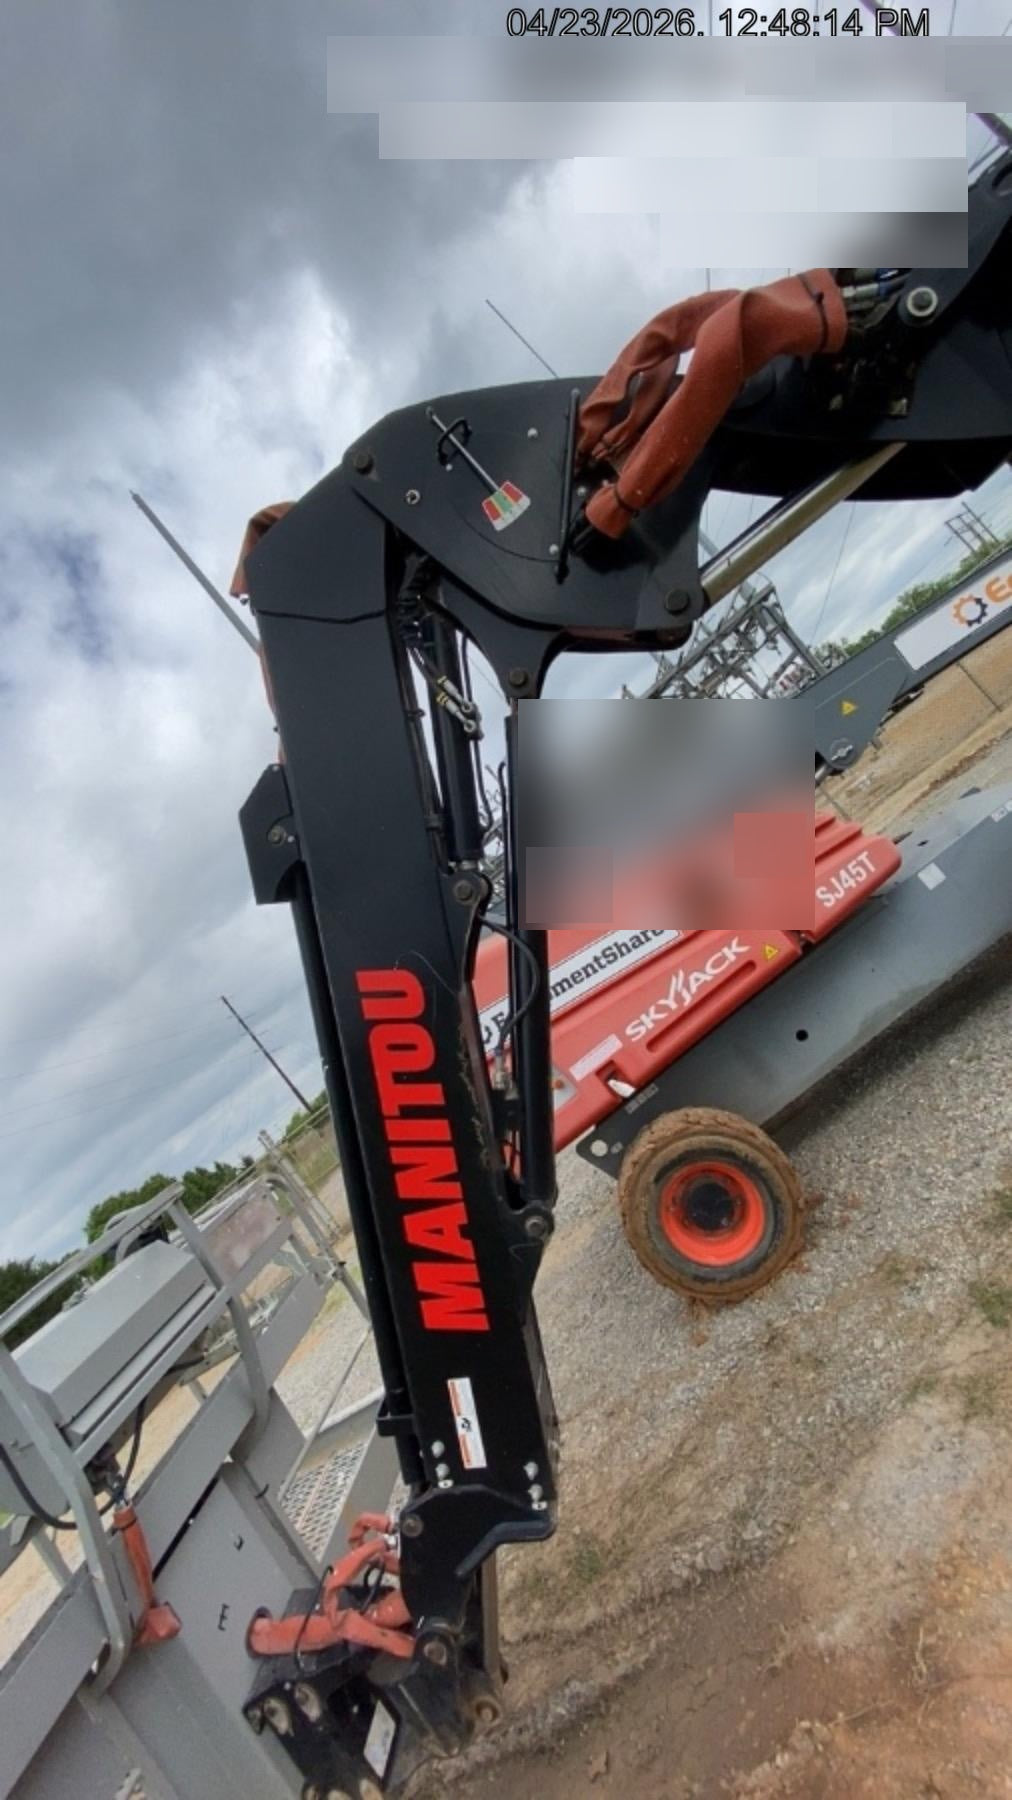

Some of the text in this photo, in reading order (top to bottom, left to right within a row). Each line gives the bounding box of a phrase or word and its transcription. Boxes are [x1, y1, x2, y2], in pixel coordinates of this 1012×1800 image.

[815, 850, 876, 908] SJ45T
[625, 936, 751, 1042] SKYJACK
[355, 968, 490, 1331] MANITOU
